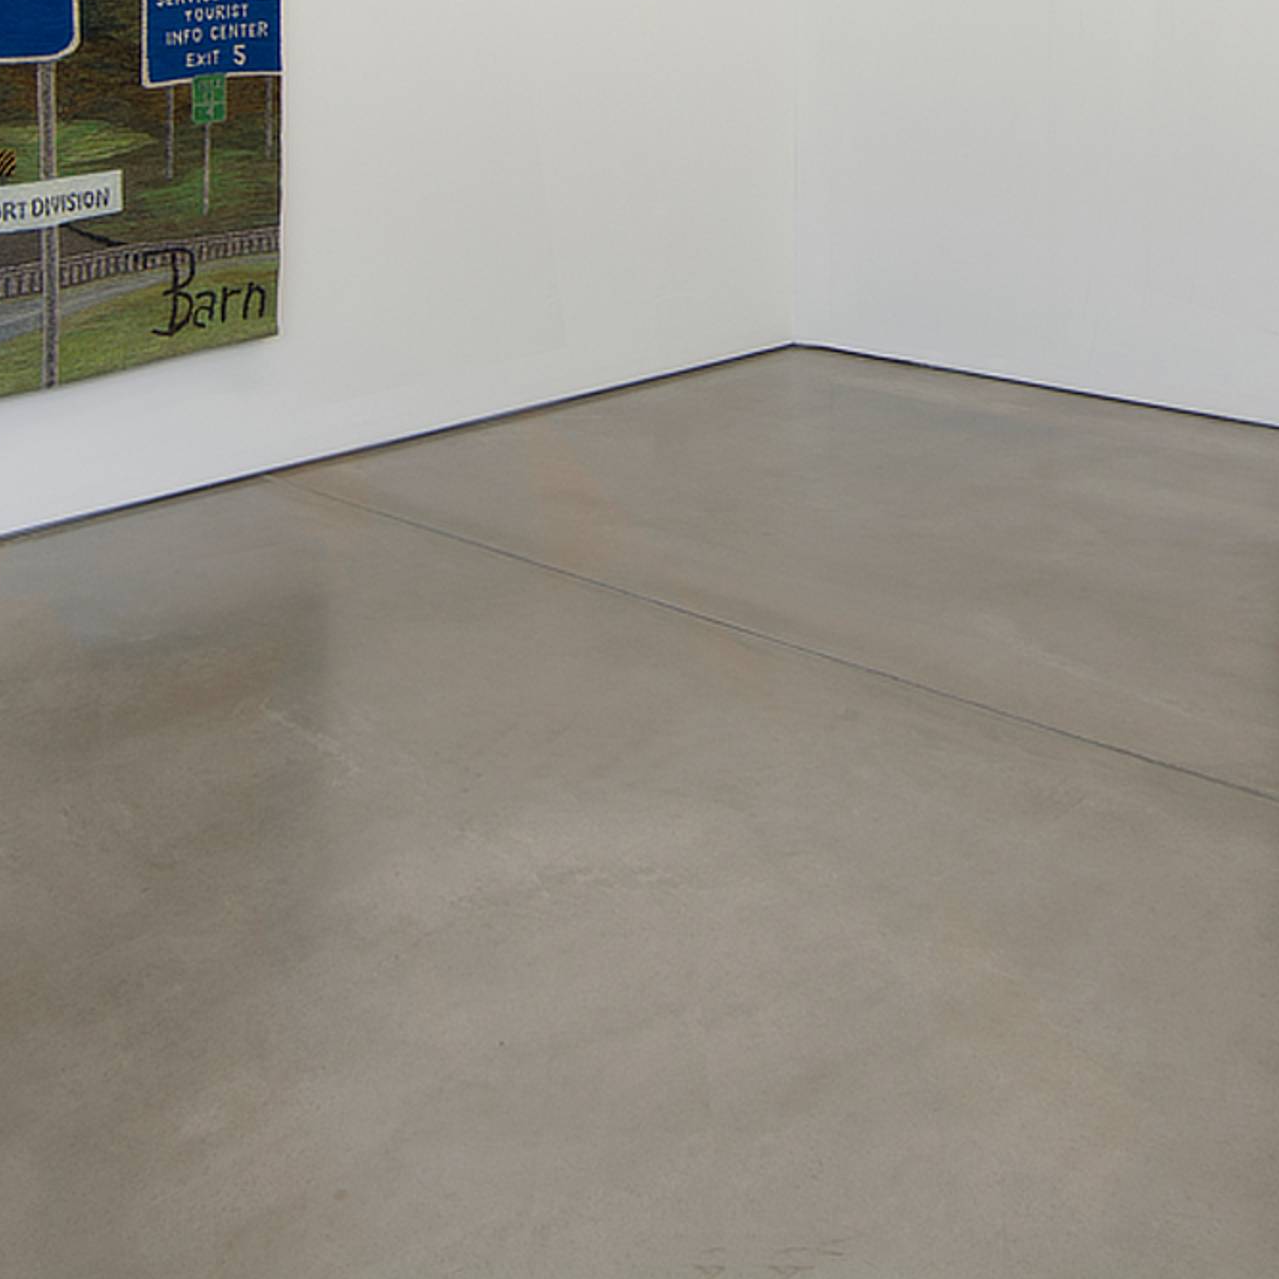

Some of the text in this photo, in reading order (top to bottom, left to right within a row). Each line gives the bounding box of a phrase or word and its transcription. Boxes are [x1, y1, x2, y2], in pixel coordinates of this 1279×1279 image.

[184, 3, 249, 22] TOURIST
[164, 20, 270, 46] INFO CENTER
[185, 44, 247, 68] EXIT 5
[31, 188, 112, 217] DIVISION
[130, 247, 267, 337] Barn
